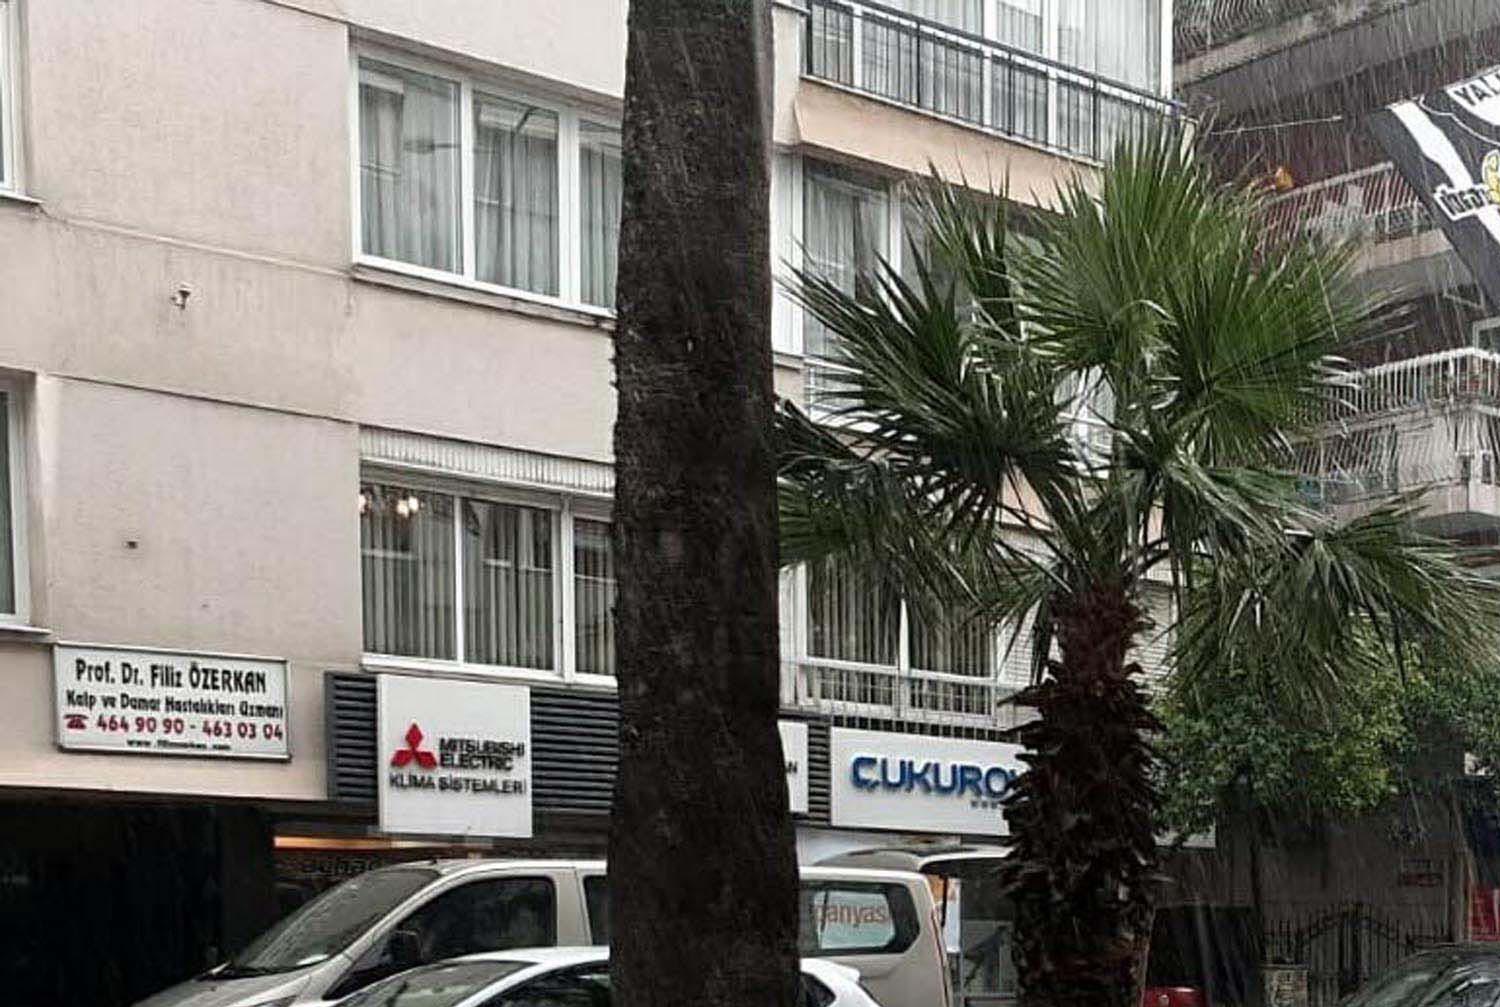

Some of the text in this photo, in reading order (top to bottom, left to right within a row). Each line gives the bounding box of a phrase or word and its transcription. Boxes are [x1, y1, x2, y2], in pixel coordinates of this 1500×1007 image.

[75, 658, 267, 694] Prof. Dr. Filiz ÖZERKAN
[66, 689, 97, 711] Kalp
[101, 695, 116, 707] ve
[120, 693, 160, 712] Damar
[97, 714, 129, 733] 464
[135, 717, 157, 733] 90
[163, 717, 185, 734] 90
[202, 720, 232, 738] 463
[237, 721, 257, 739] 03
[263, 724, 284, 741] 04
